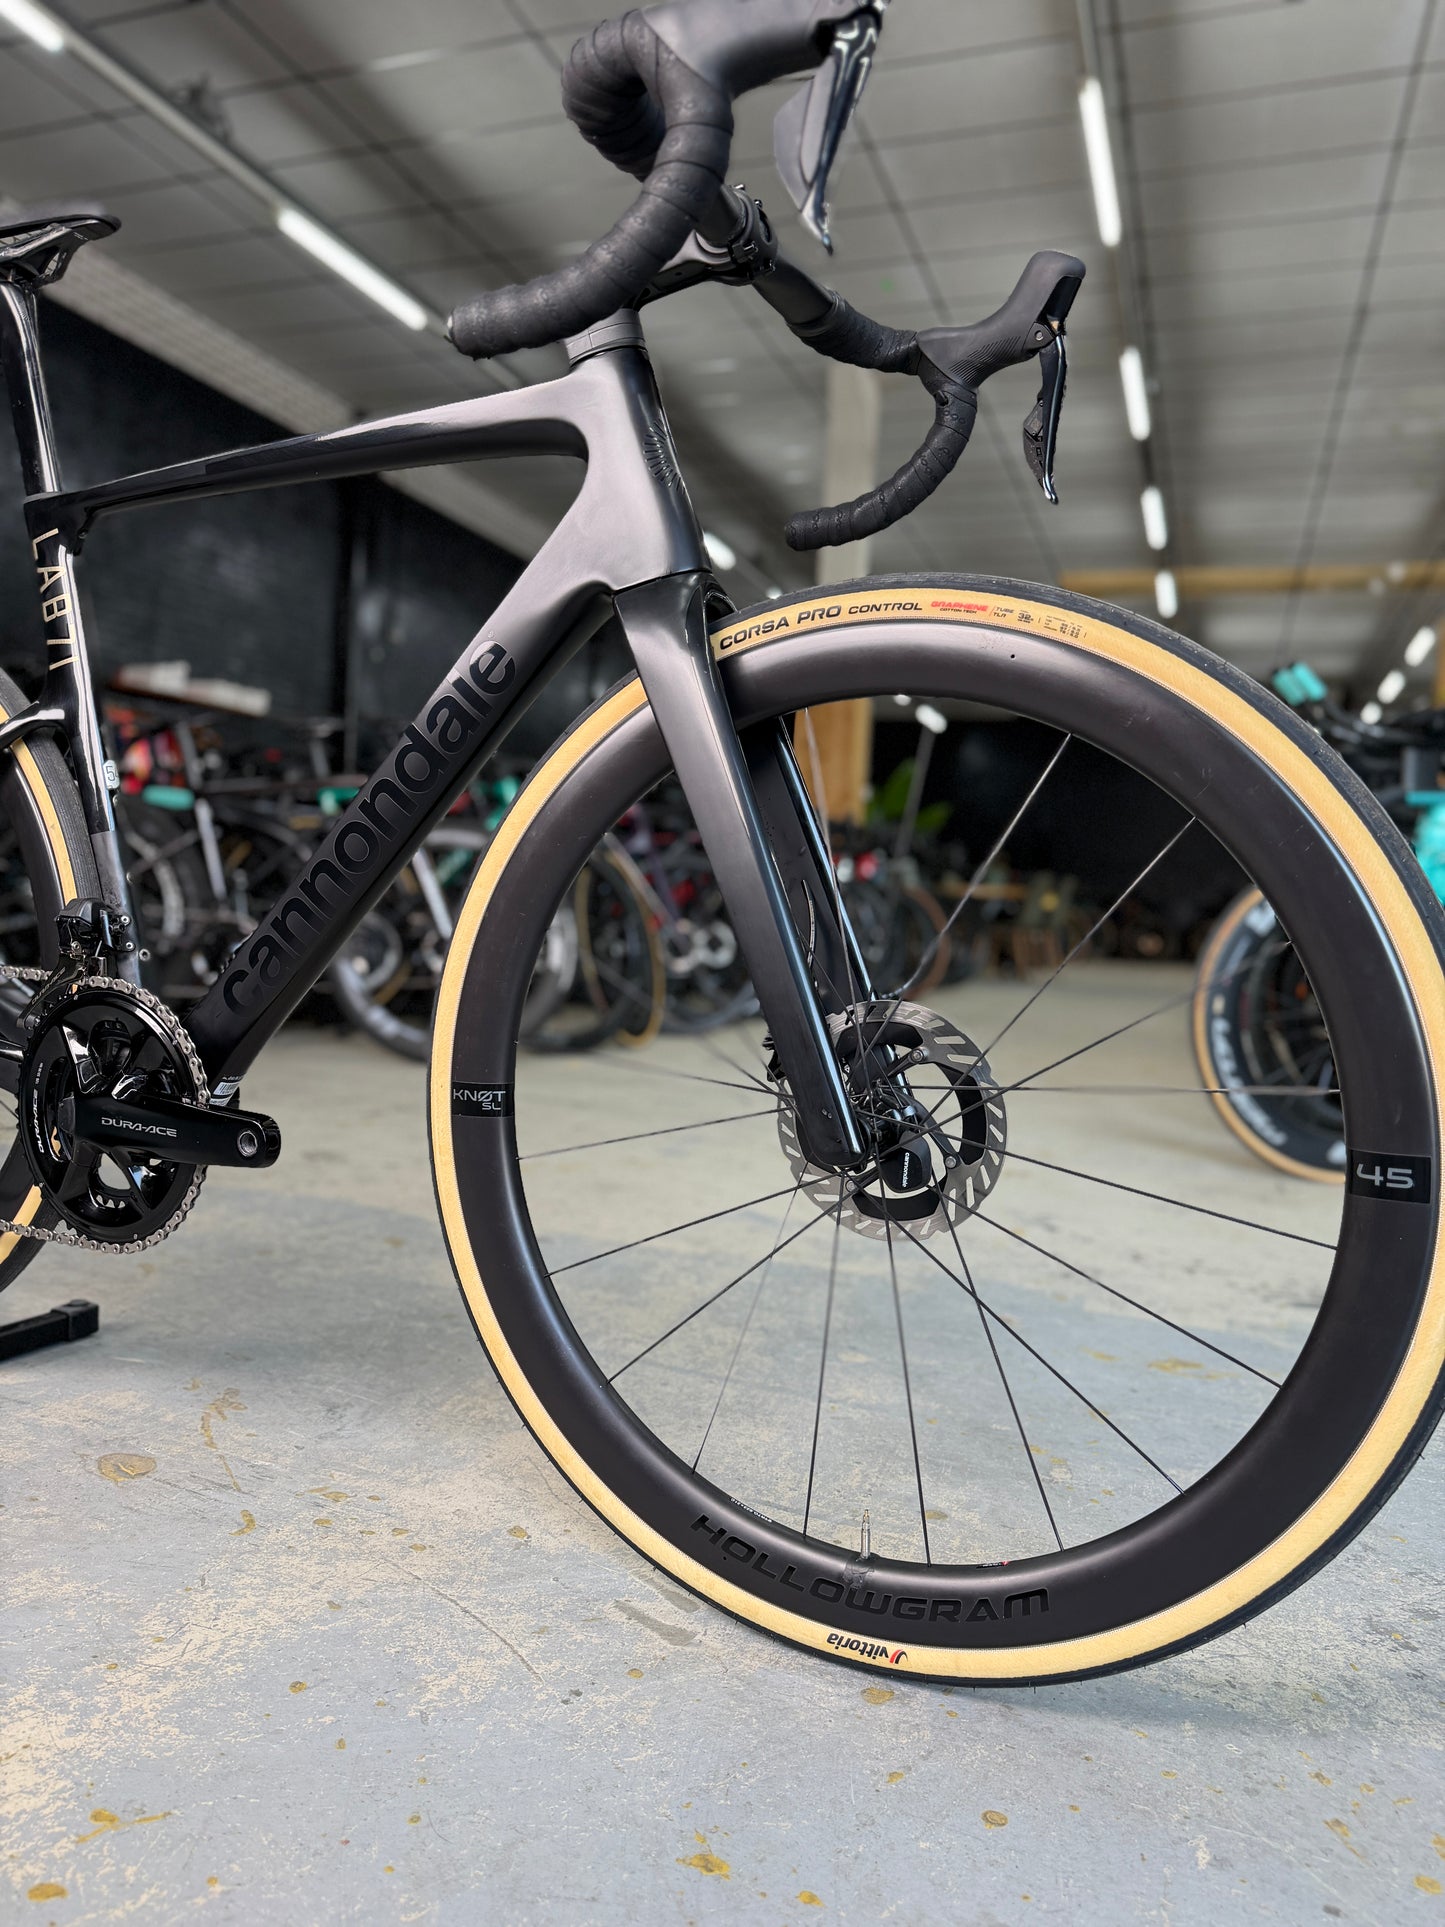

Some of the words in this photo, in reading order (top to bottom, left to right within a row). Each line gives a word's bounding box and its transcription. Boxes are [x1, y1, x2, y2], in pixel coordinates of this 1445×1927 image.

[32, 527, 79, 671] LAB71
[931, 600, 989, 612] GRAPHENE
[720, 616, 790, 650] CORSA
[797, 604, 842, 625] PRO
[848, 602, 923, 615] CONTROL
[222, 640, 516, 1016] cannondale
[33, 1088, 45, 1154] DURA-ACE
[482, 1102, 501, 1110] SL
[101, 1117, 177, 1138] DURA-ACE
[901, 1152, 910, 1188] cannondale
[1356, 1163, 1414, 1189] 45
[690, 1513, 1050, 1624] HOLLOWGRAM
[826, 1633, 889, 1660] vittoria
